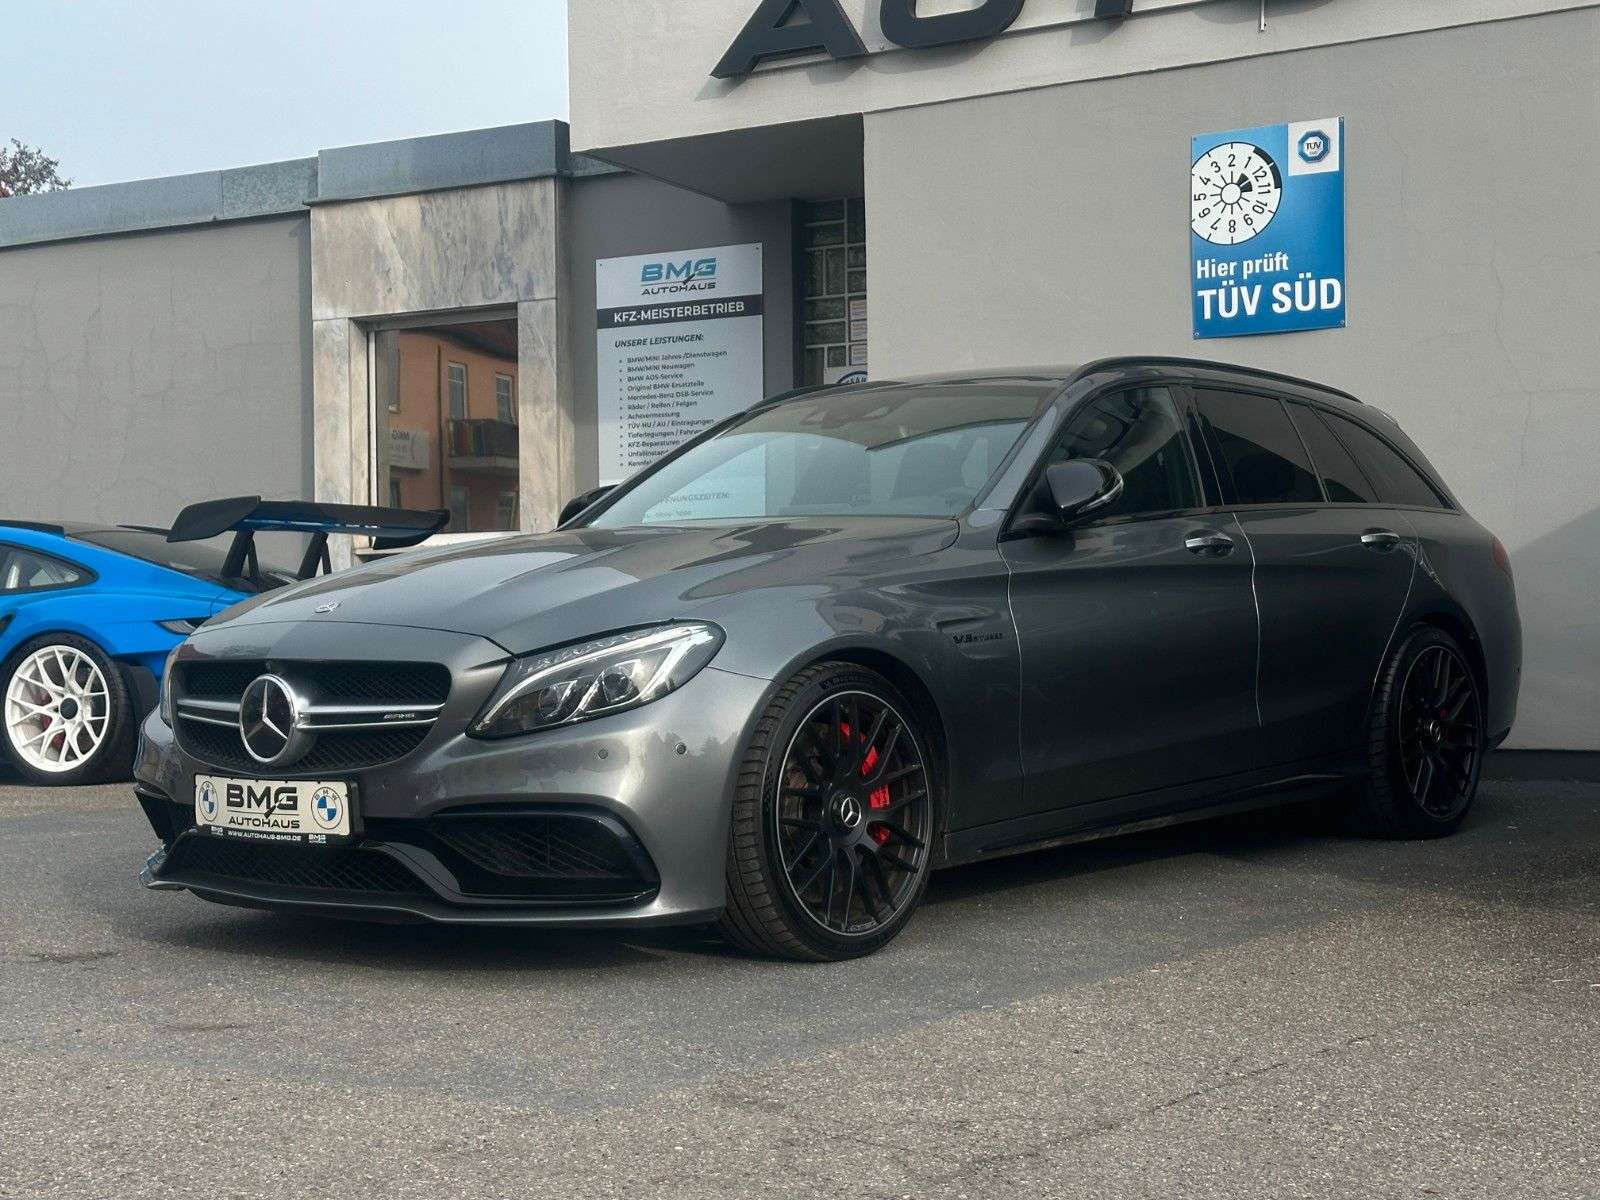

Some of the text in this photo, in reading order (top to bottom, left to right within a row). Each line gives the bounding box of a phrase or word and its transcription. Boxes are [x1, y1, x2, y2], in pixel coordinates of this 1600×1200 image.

[1228, 154, 1236, 167] 2
[1244, 156, 1252, 168] 1
[1210, 161, 1221, 173] 3
[1252, 166, 1267, 182] 12
[1200, 176, 1210, 186] 4
[1258, 183, 1270, 194] 11
[1194, 193, 1206, 201] 5
[1199, 208, 1210, 218] 6
[1252, 200, 1268, 214] 10
[1210, 218, 1221, 230] 7
[1244, 214, 1254, 226] 9
[1228, 220, 1236, 233] 8
[641, 258, 716, 282] BMG
[1196, 251, 1289, 280] Hier prüft
[642, 282, 716, 296] AUTOHAUS
[1198, 272, 1342, 320] TÜV SÜD
[614, 302, 745, 323] KFZ-MEISTERBETRIEB
[614, 334, 704, 348] UNSERE LEISTUNGEN:
[627, 384, 652, 392] Original
[672, 380, 704, 388] Ersatzteile
[650, 401, 671, 409] Reifen
[676, 400, 698, 408] Felgen
[628, 411, 680, 420] Achsvermessung
[671, 418, 714, 427] Eintragungen
[628, 430, 674, 440] Tieferlegungen
[226, 784, 298, 811] BMG
[228, 816, 300, 828] AUTOHAUS
